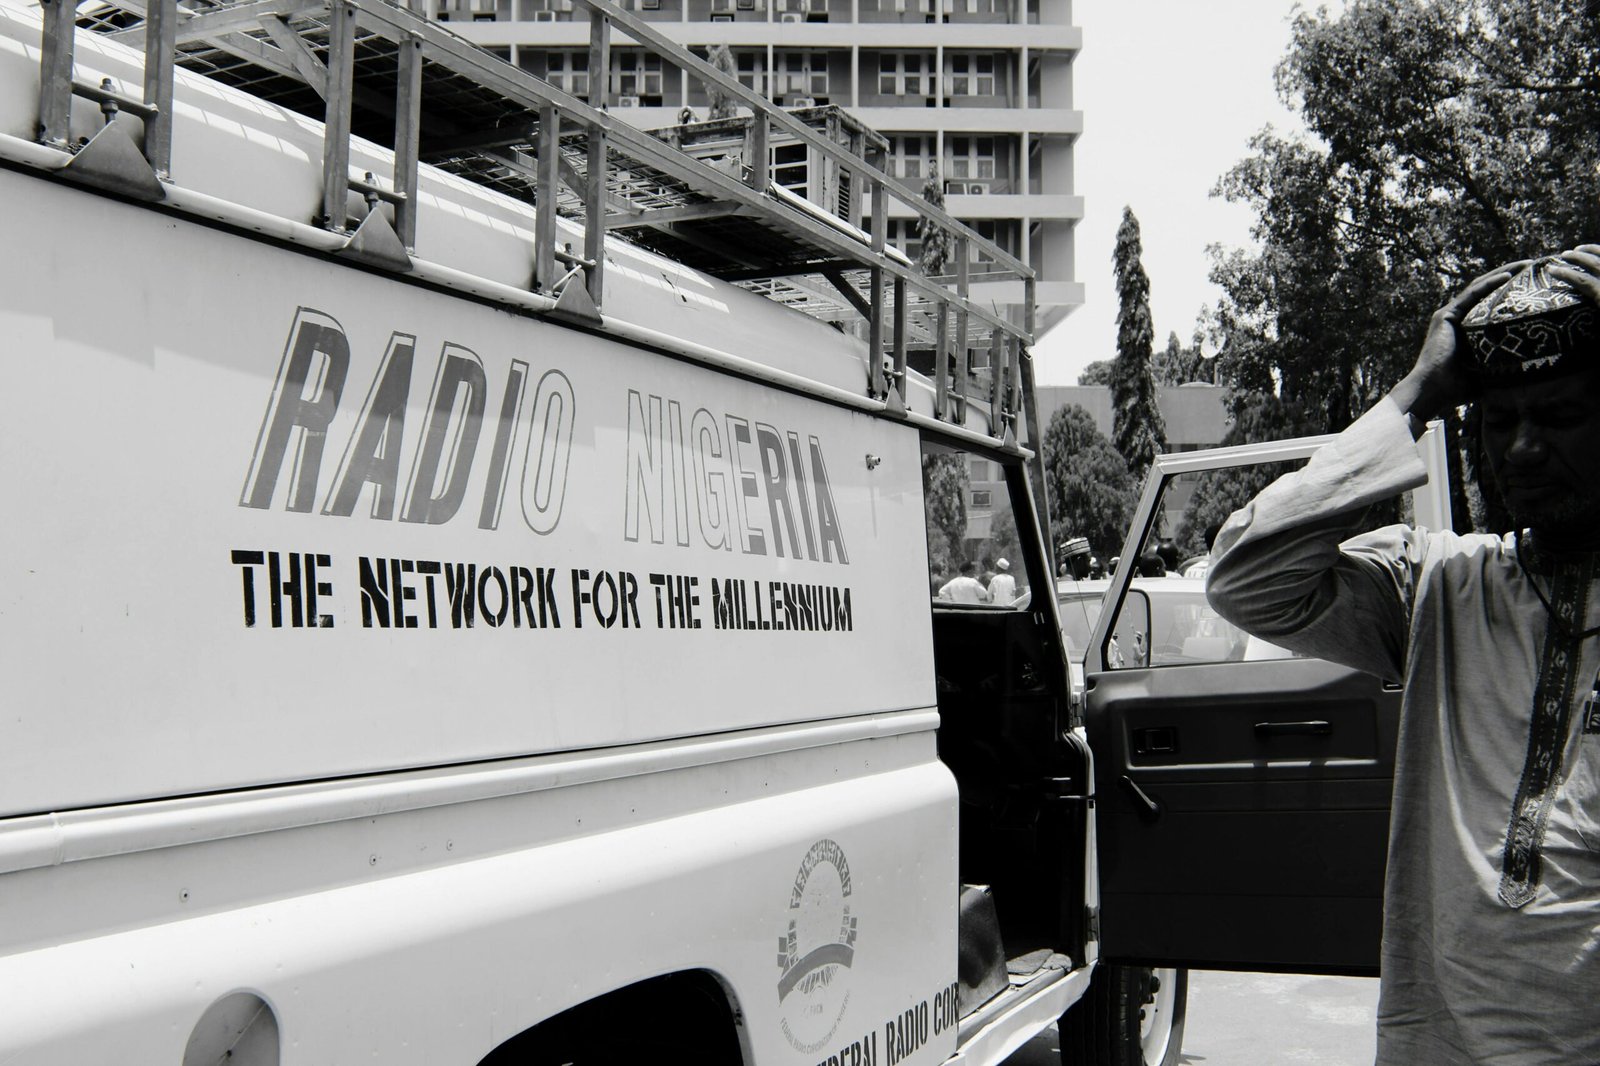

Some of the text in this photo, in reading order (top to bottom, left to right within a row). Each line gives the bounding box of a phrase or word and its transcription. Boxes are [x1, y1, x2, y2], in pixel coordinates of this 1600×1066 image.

[240, 307, 849, 565] RADIO NIGERIA
[232, 550, 852, 632] THE NETWORK FOR THE MILLENNIUM
[885, 1000, 928, 1066] RADIO
